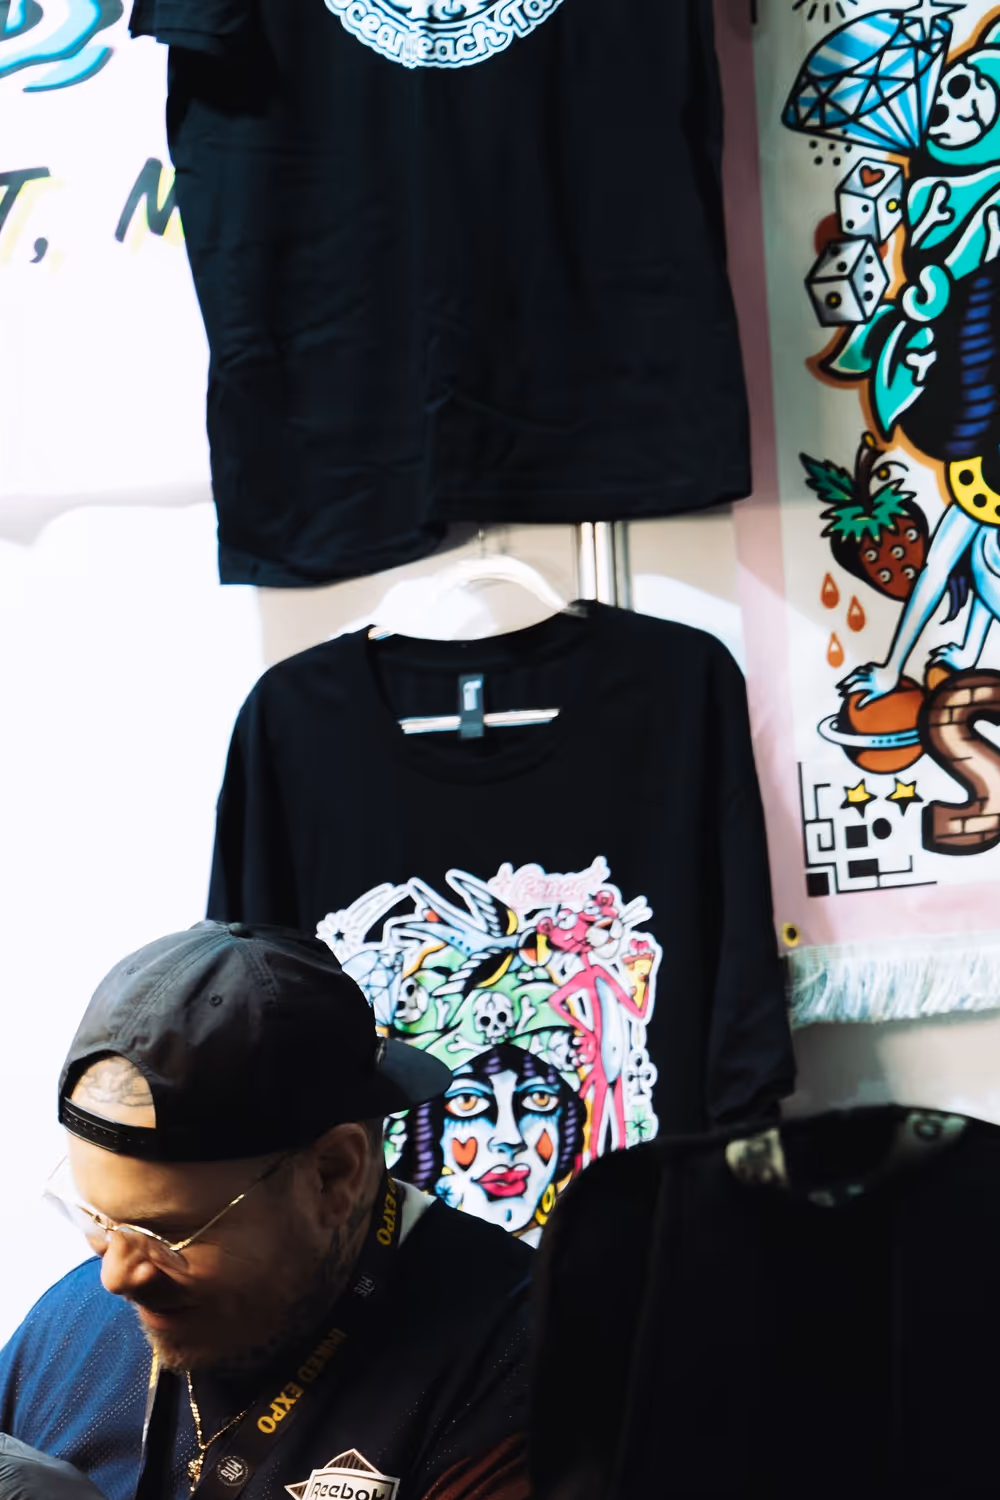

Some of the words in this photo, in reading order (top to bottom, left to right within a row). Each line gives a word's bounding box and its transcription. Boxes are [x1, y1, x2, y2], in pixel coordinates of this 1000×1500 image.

[404, 21, 509, 62] each
[376, 1193, 397, 1245] EXPO
[297, 1327, 348, 1383] INKED
[257, 1381, 305, 1434] EXPO
[219, 1458, 245, 1484] MTS
